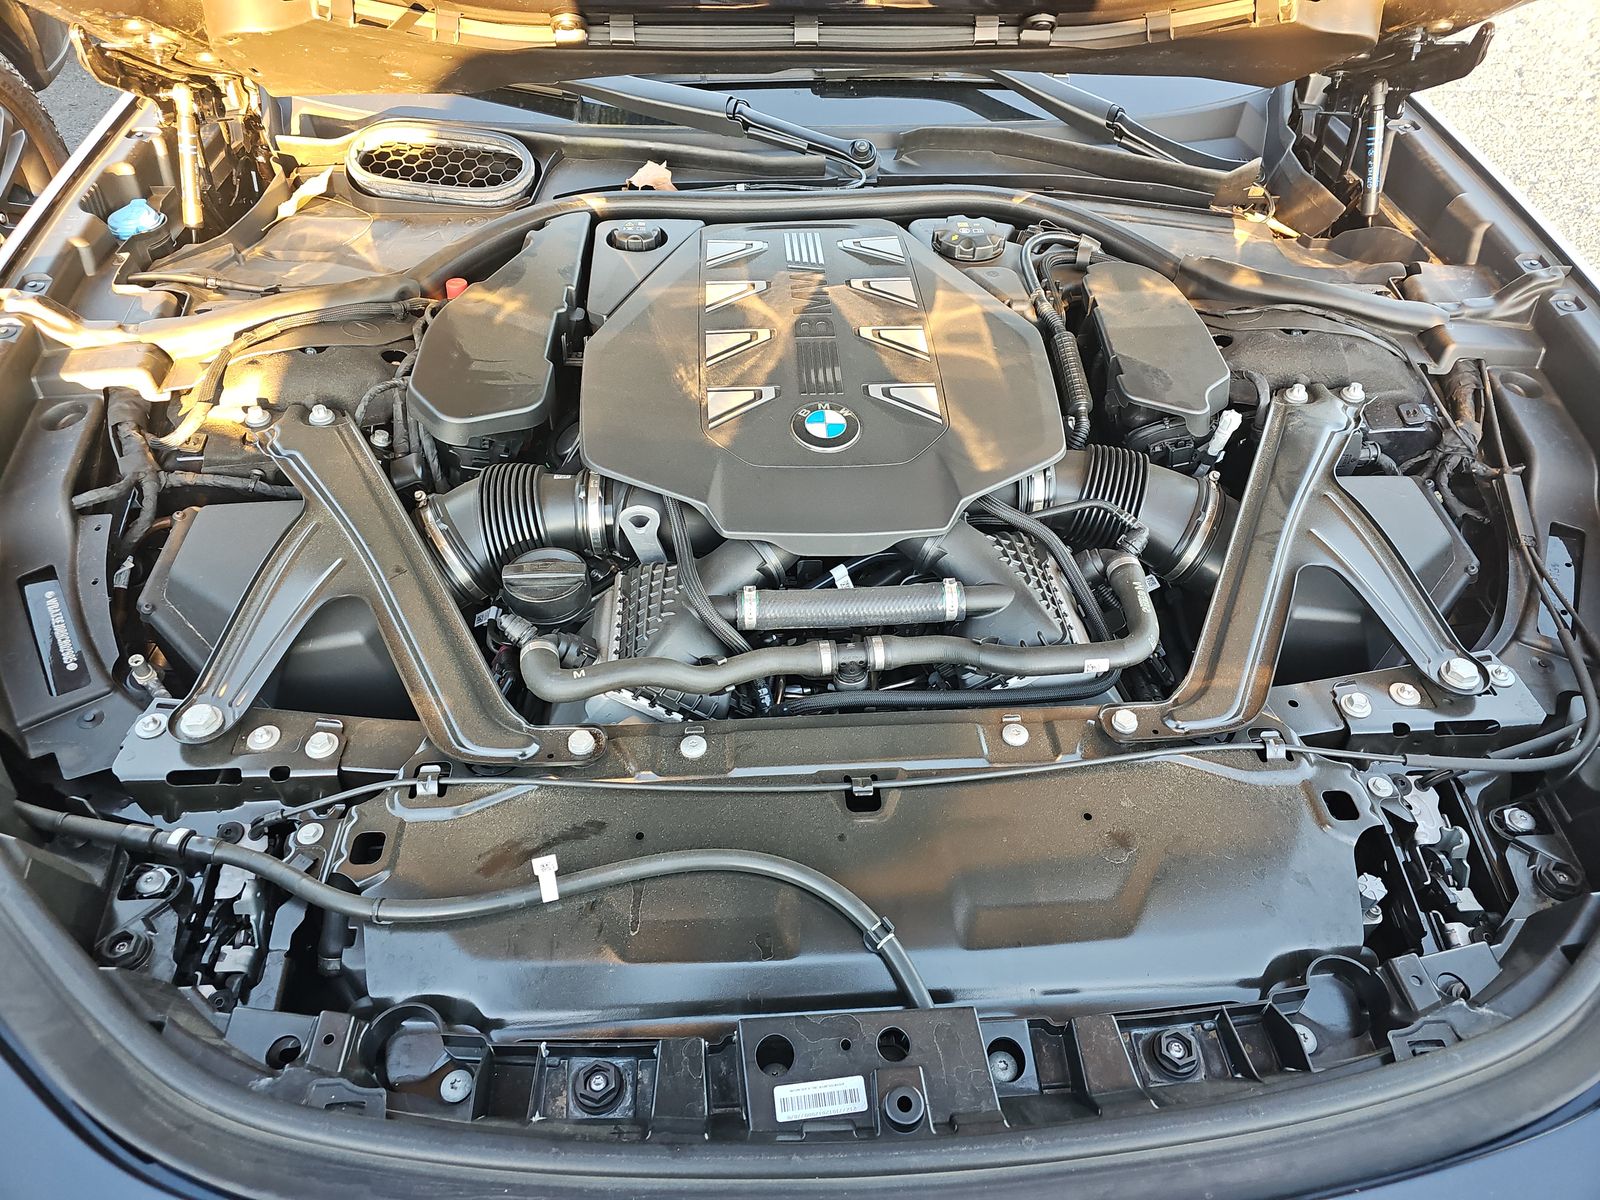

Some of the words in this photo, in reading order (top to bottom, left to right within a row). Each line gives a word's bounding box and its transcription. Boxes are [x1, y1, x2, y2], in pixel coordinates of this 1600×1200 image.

[787, 264, 837, 339] BMW
[798, 402, 853, 417] BMW
[572, 669, 586, 679] M
